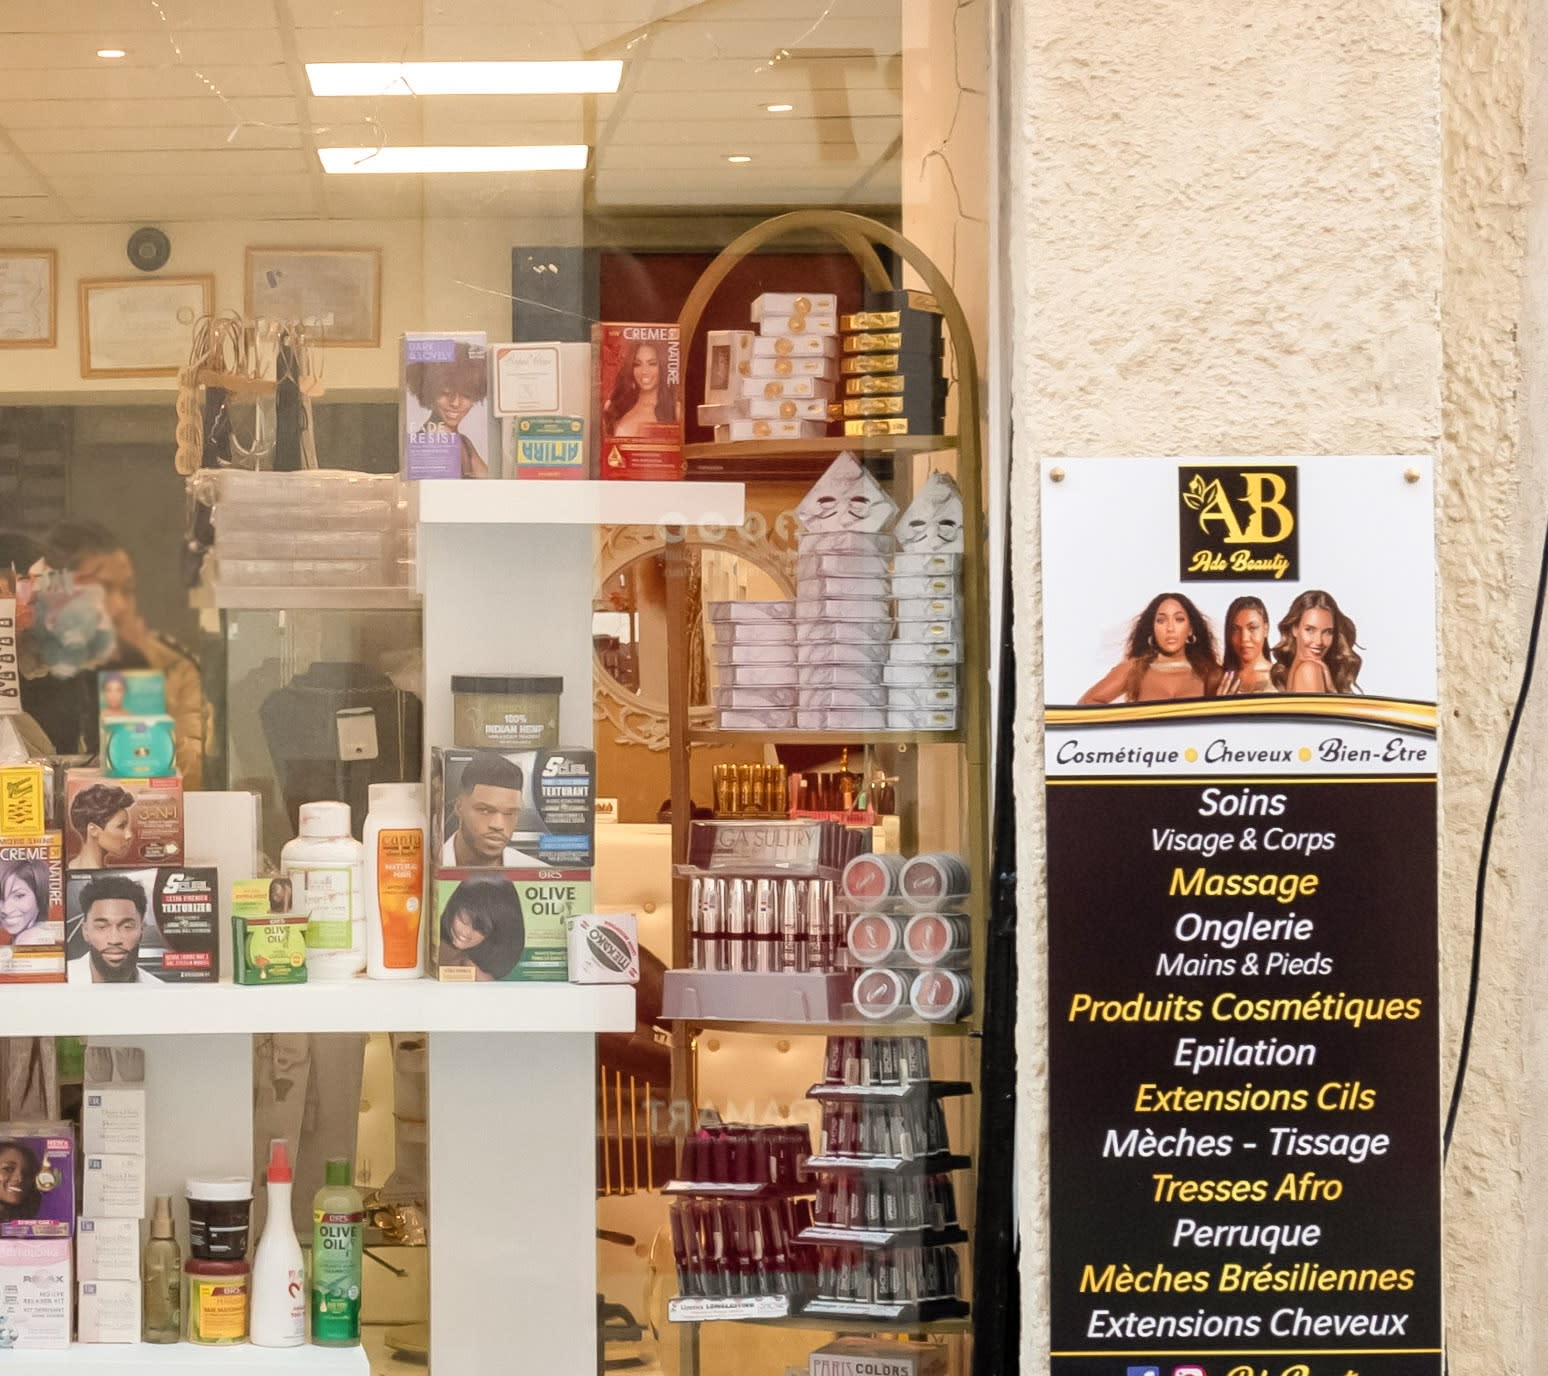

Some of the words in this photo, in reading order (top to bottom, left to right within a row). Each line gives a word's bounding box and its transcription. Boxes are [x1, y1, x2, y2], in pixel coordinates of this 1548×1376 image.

[1199, 472, 1296, 544] AB
[1187, 549, 1228, 574] Ade
[1230, 550, 1290, 579] Beauty
[1056, 739, 1179, 768] Cosmétique
[1204, 738, 1293, 764] Cheveux
[1318, 736, 1428, 763] Bien-Etre
[1198, 787, 1288, 817] Soins
[0, 847, 47, 861] CREME
[1152, 828, 1235, 858] Visage
[1239, 827, 1257, 851] &
[1263, 827, 1336, 857] Corps
[525, 886, 576, 901] OLIVE
[1169, 867, 1319, 904] Massage
[531, 902, 561, 915] OIL
[1175, 911, 1314, 949] Onglerie
[1155, 952, 1237, 977] Mains
[1240, 952, 1259, 976] &
[1265, 951, 1334, 976] Pieds
[1068, 992, 1204, 1022] Produits
[1211, 991, 1422, 1028] Cosmétiques
[1174, 1036, 1317, 1075] Epilation
[1134, 1082, 1309, 1112] Extensions
[1317, 1081, 1377, 1111] Cils
[1102, 1127, 1234, 1158] Mèches
[1269, 1127, 1390, 1164] Tissage
[1152, 1173, 1269, 1203] Tresses
[1273, 1171, 1343, 1202] Afro
[1172, 1218, 1321, 1255] Perruque
[1079, 1263, 1211, 1293] Mèches
[1218, 1262, 1416, 1292] Brésiliennes
[1087, 1308, 1262, 1338] Extensions
[1270, 1307, 1409, 1337] Cheveux
